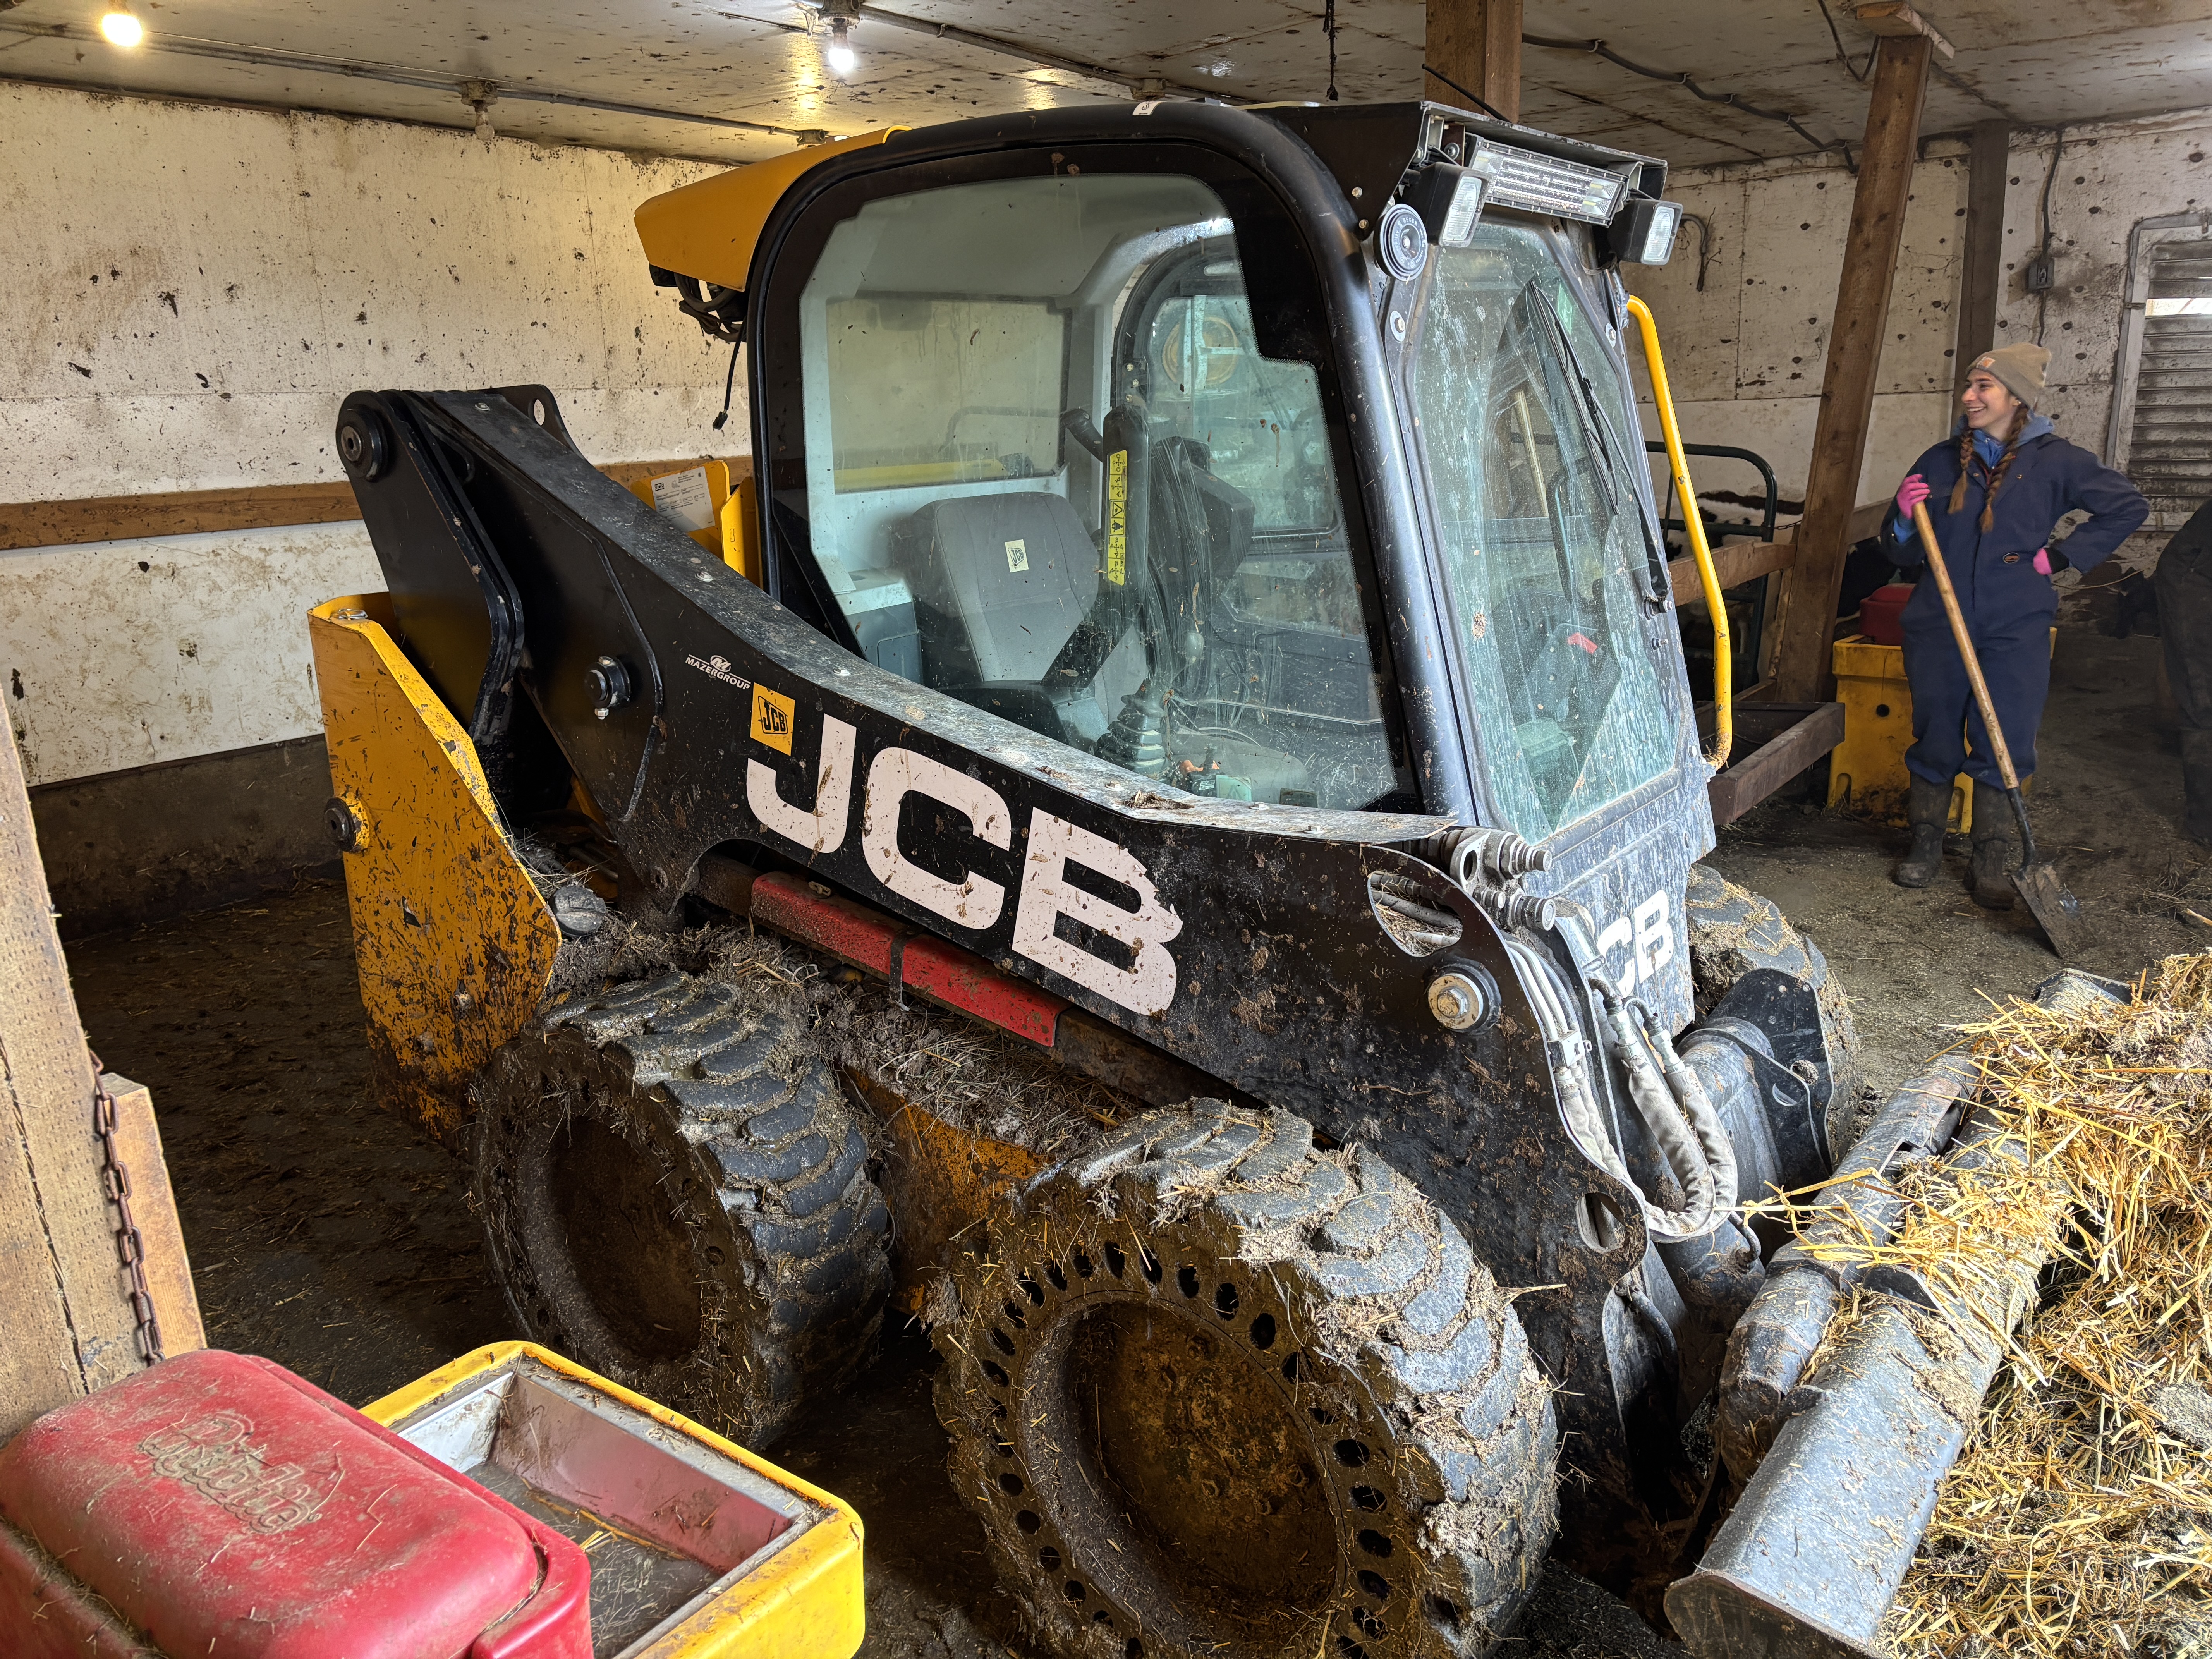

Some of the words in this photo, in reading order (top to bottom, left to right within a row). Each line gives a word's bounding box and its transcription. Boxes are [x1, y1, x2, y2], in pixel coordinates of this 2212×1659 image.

[655, 483, 664, 491] JCB
[1010, 549, 1024, 563] JCB
[685, 656, 750, 690] MAZERGROUP
[763, 701, 786, 732] JCB
[747, 713, 1183, 1016] JCB
[1597, 890, 1674, 998] CB
